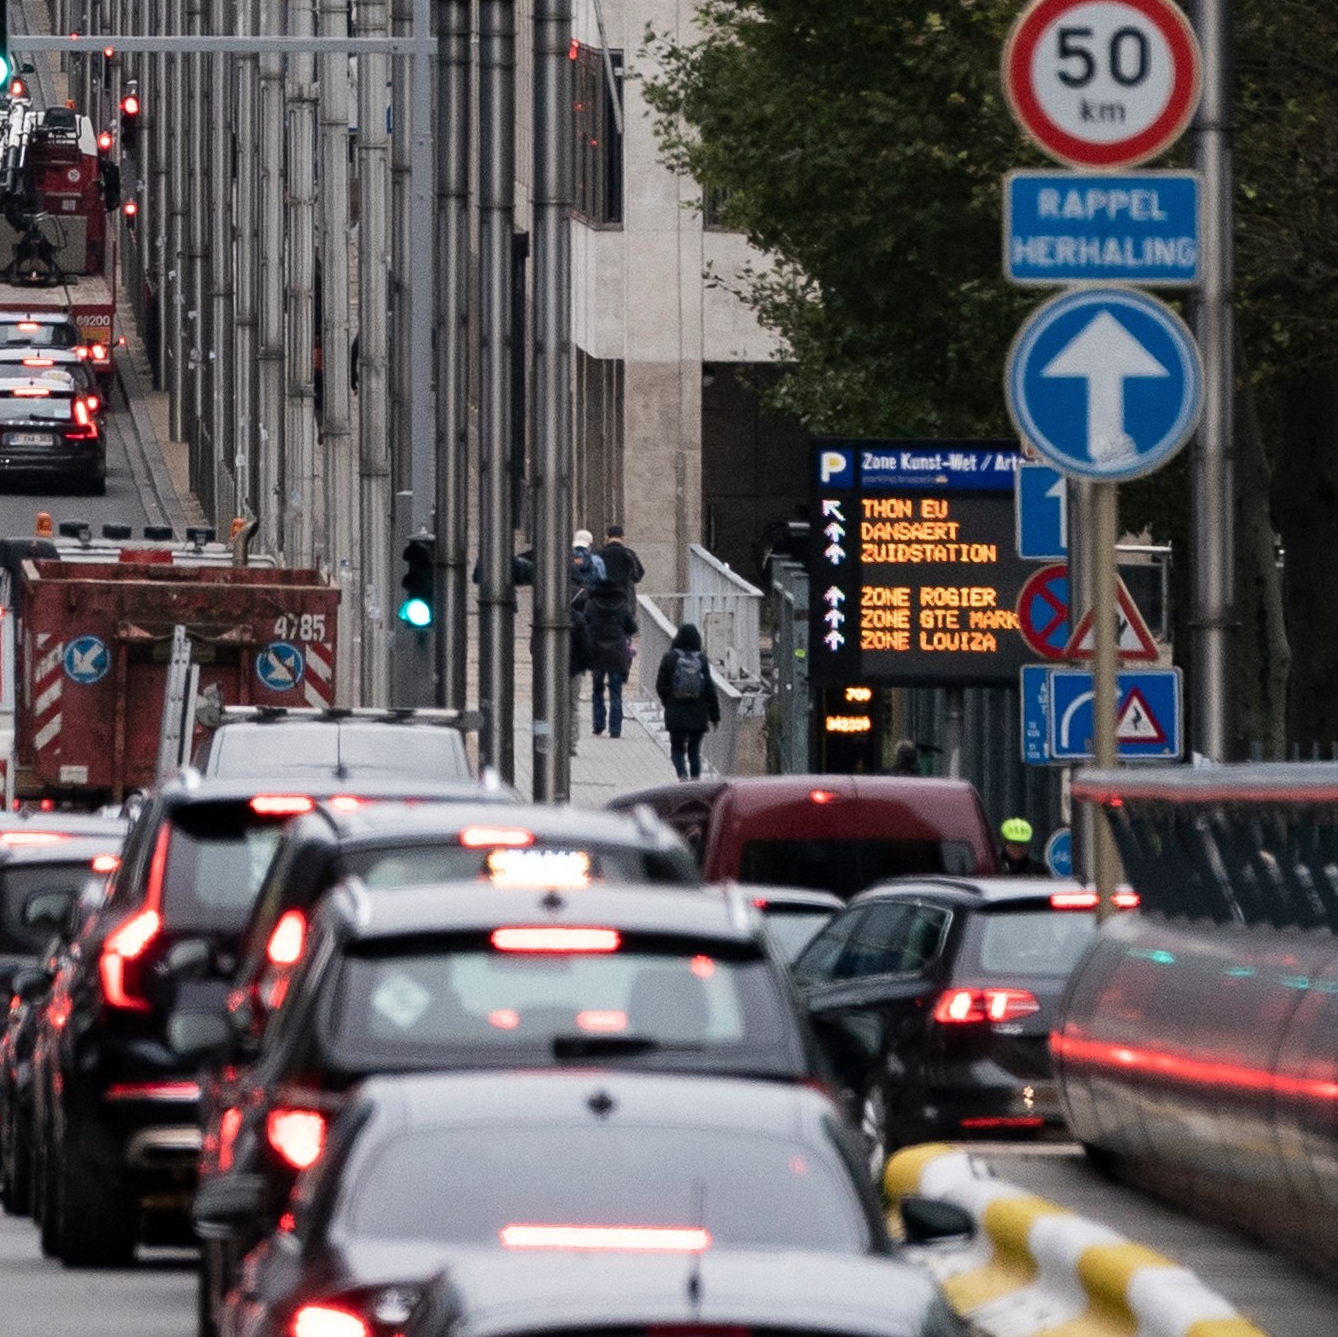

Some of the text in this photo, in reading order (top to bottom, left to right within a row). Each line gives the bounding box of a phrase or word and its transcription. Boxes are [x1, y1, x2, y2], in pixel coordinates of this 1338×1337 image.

[1057, 26, 1153, 89] 50
[1081, 99, 1126, 123] km
[1038, 188, 1167, 221] RAPPEL
[1012, 236, 1198, 267] HERHALING
[821, 452, 847, 483] P
[862, 452, 896, 470] Zone
[901, 452, 977, 471] Kunst-Wet
[862, 499, 949, 519] THON EU
[861, 522, 960, 541] DANSAERT
[861, 544, 997, 563] ZUIDSTATION
[861, 586, 997, 607] ZONE ROGIER
[274, 613, 326, 642] 4785
[861, 610, 911, 629] ZONE
[919, 609, 960, 629] GTE
[861, 631, 997, 652] ZONE LOUIZA
